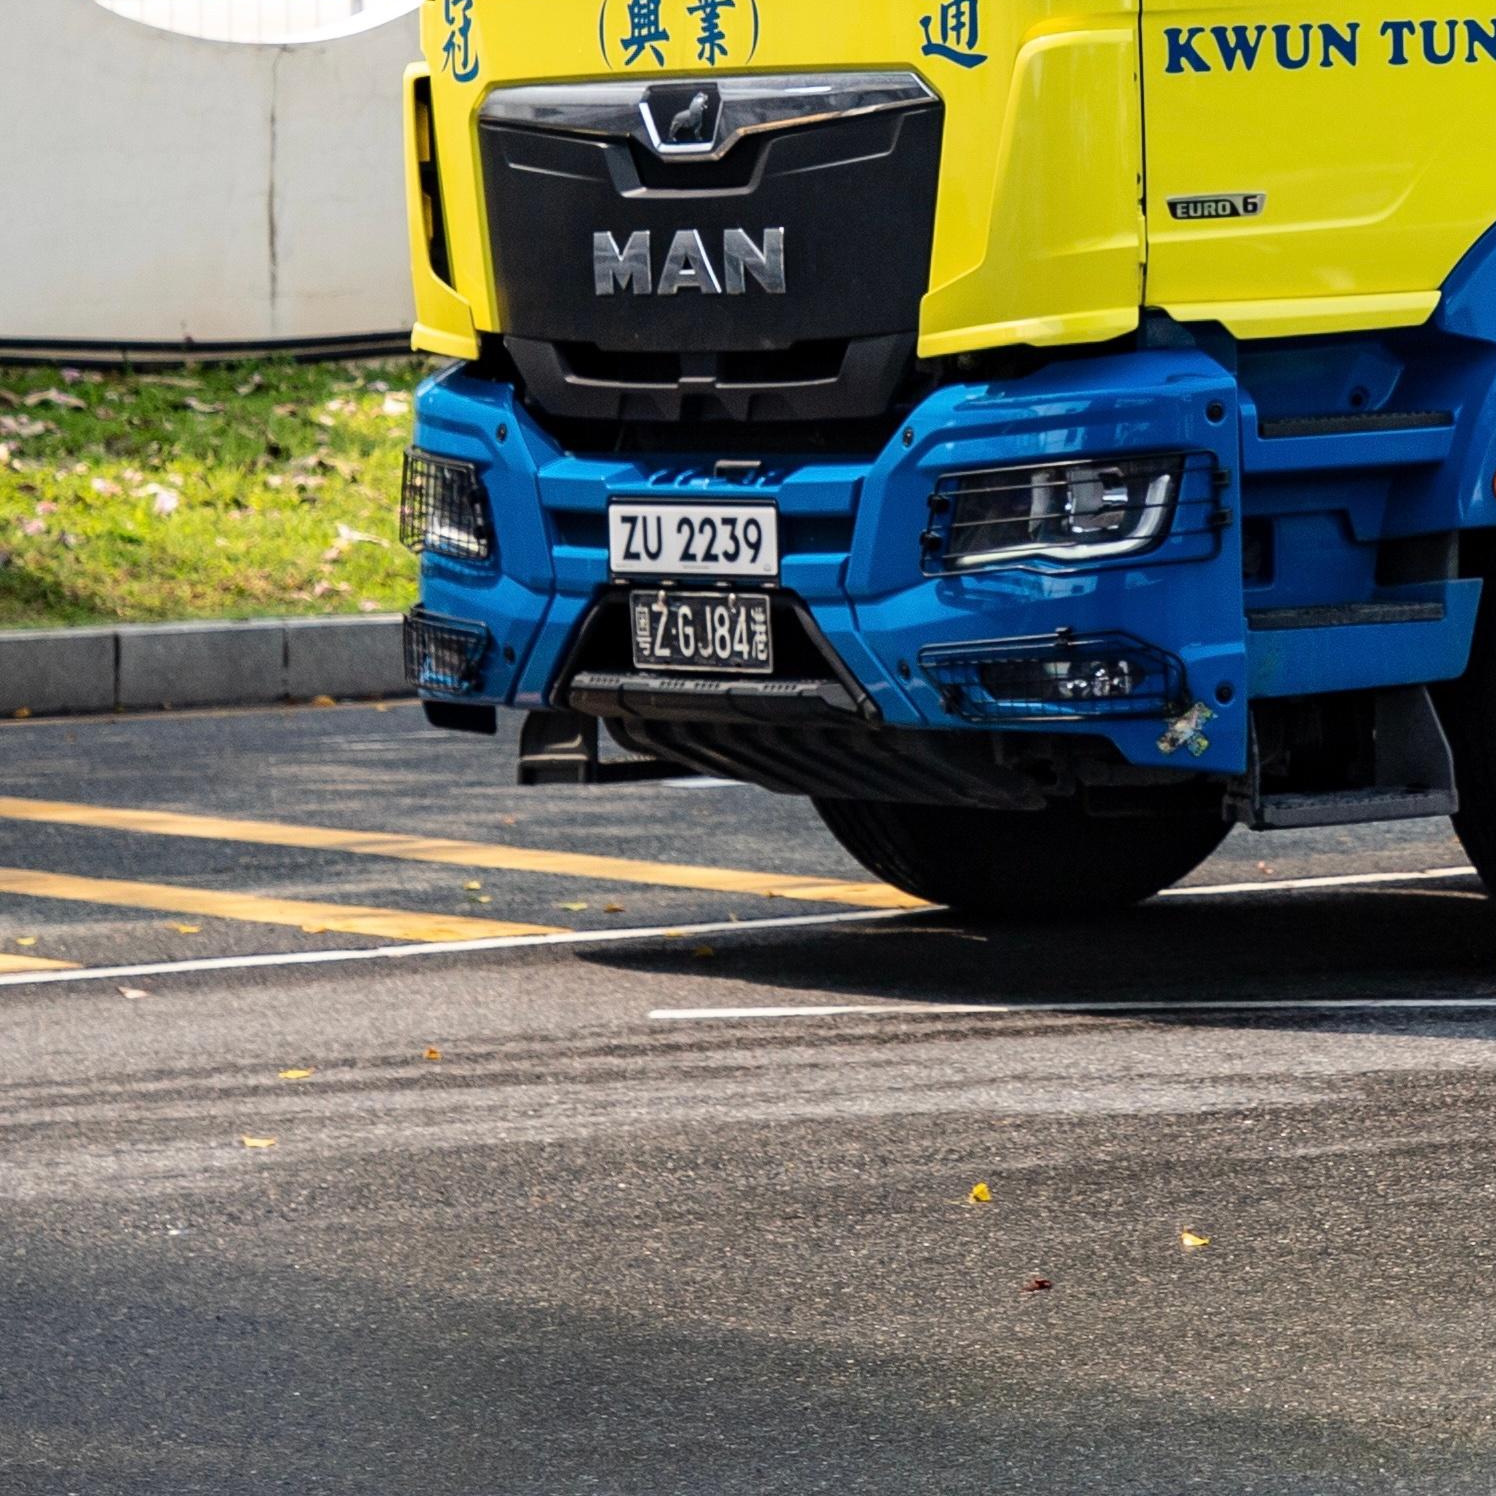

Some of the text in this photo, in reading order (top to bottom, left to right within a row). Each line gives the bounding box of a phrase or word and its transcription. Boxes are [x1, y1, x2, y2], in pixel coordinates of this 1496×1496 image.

[1163, 22, 1360, 73] KWUN
[1176, 196, 1258, 218] EURO 6
[593, 227, 786, 295] MAN
[620, 516, 762, 564] ZU 2239
